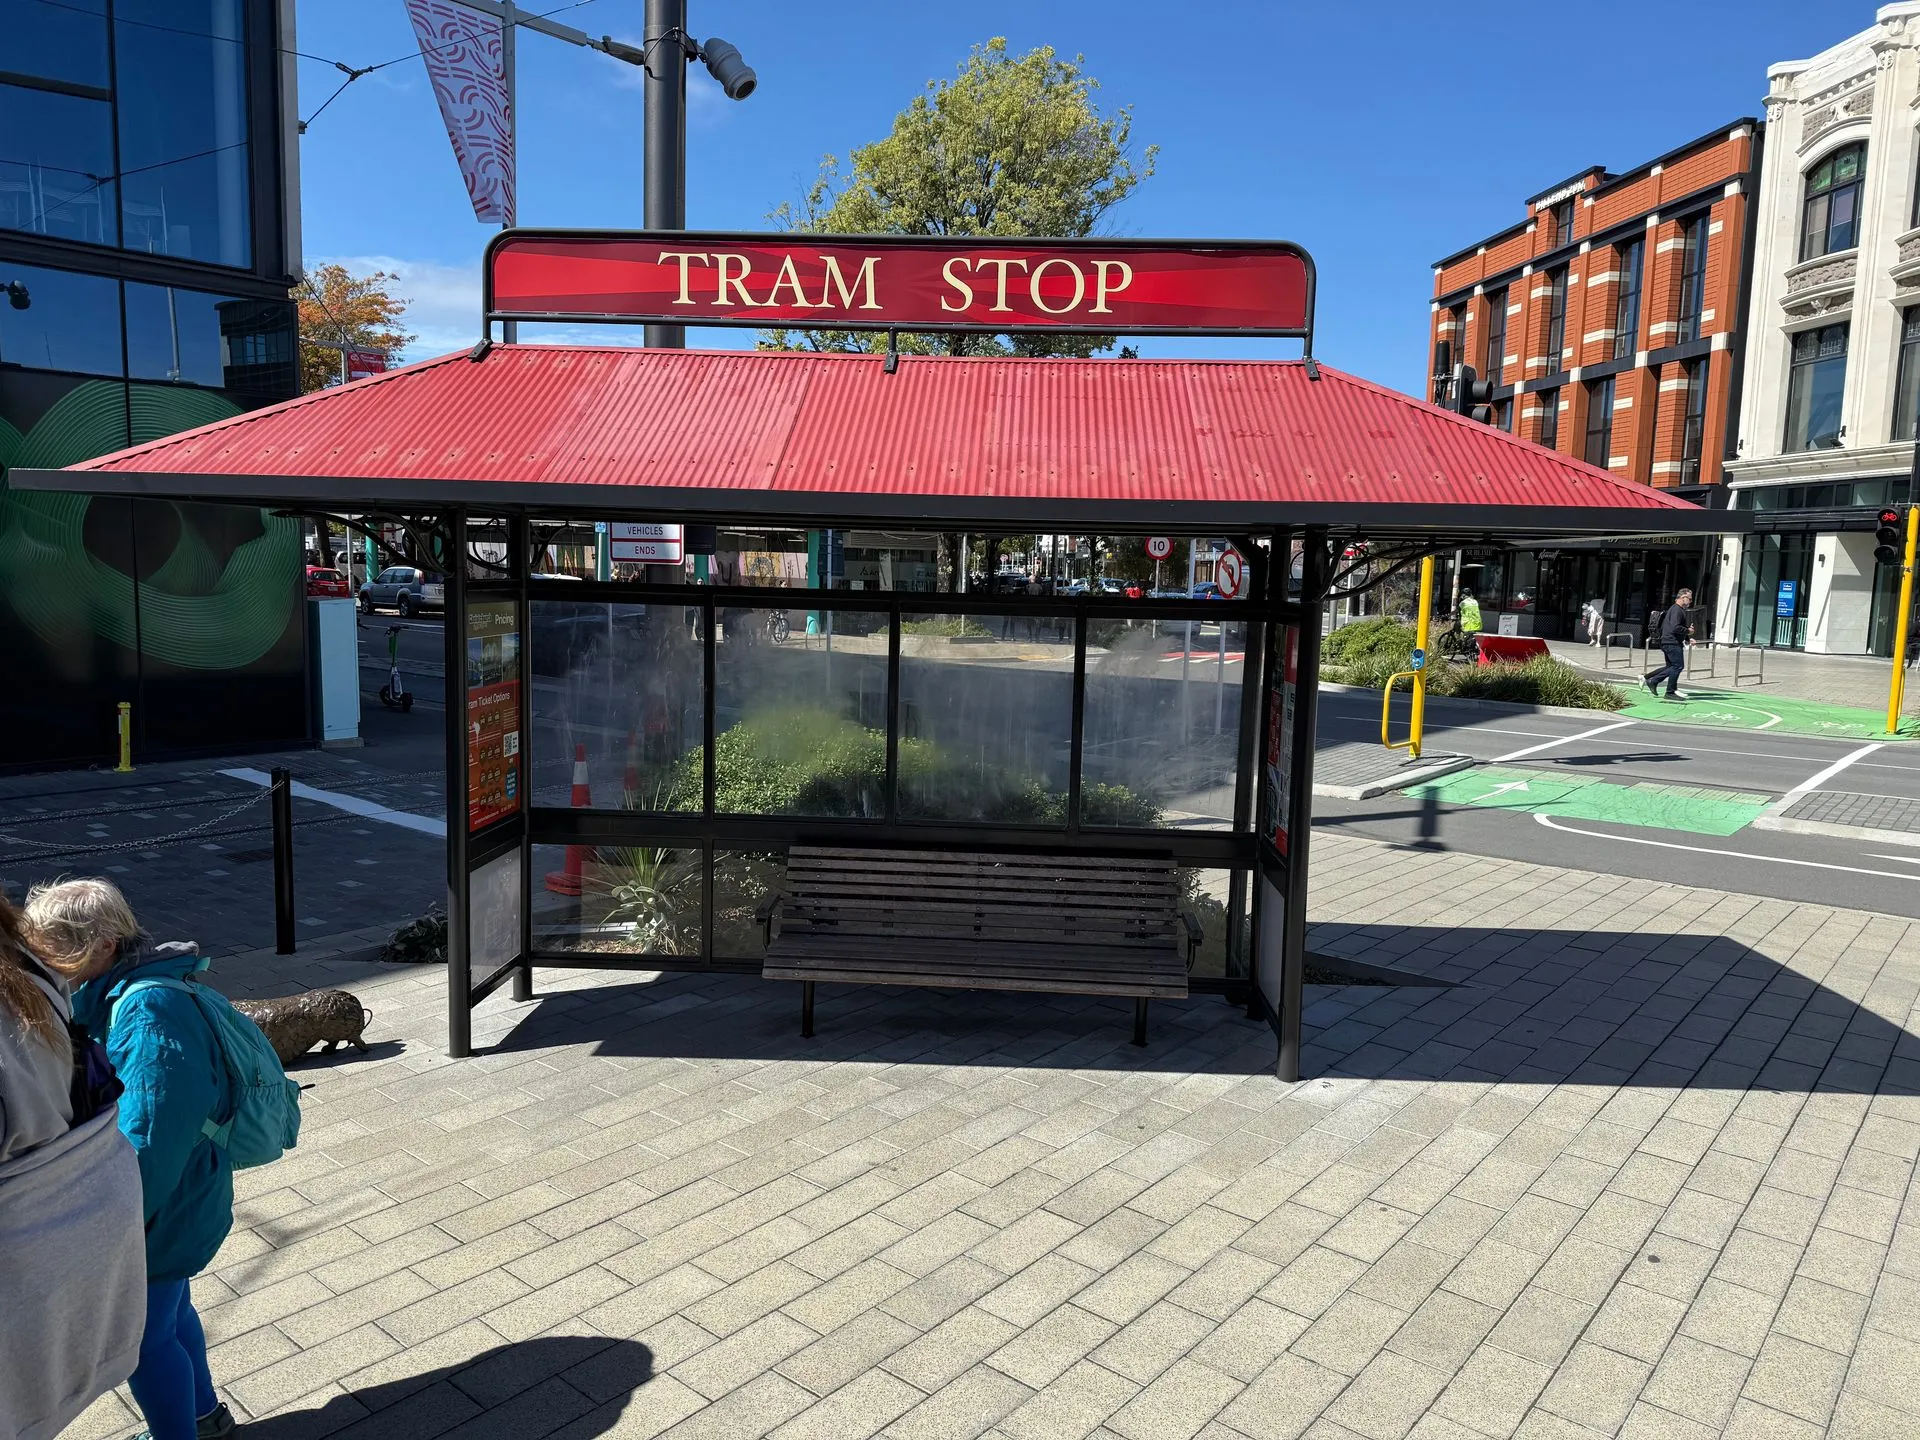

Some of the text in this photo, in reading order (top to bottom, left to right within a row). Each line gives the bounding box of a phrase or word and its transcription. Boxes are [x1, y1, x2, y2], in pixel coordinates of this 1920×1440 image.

[657, 251, 1134, 314] TRAM STOP
[627, 526, 664, 536] VEHICLES
[634, 545, 656, 555] ENDS
[1153, 540, 1165, 552] 10
[494, 612, 515, 626] Pricing
[478, 695, 493, 707] Ticket
[493, 691, 511, 705] Options
